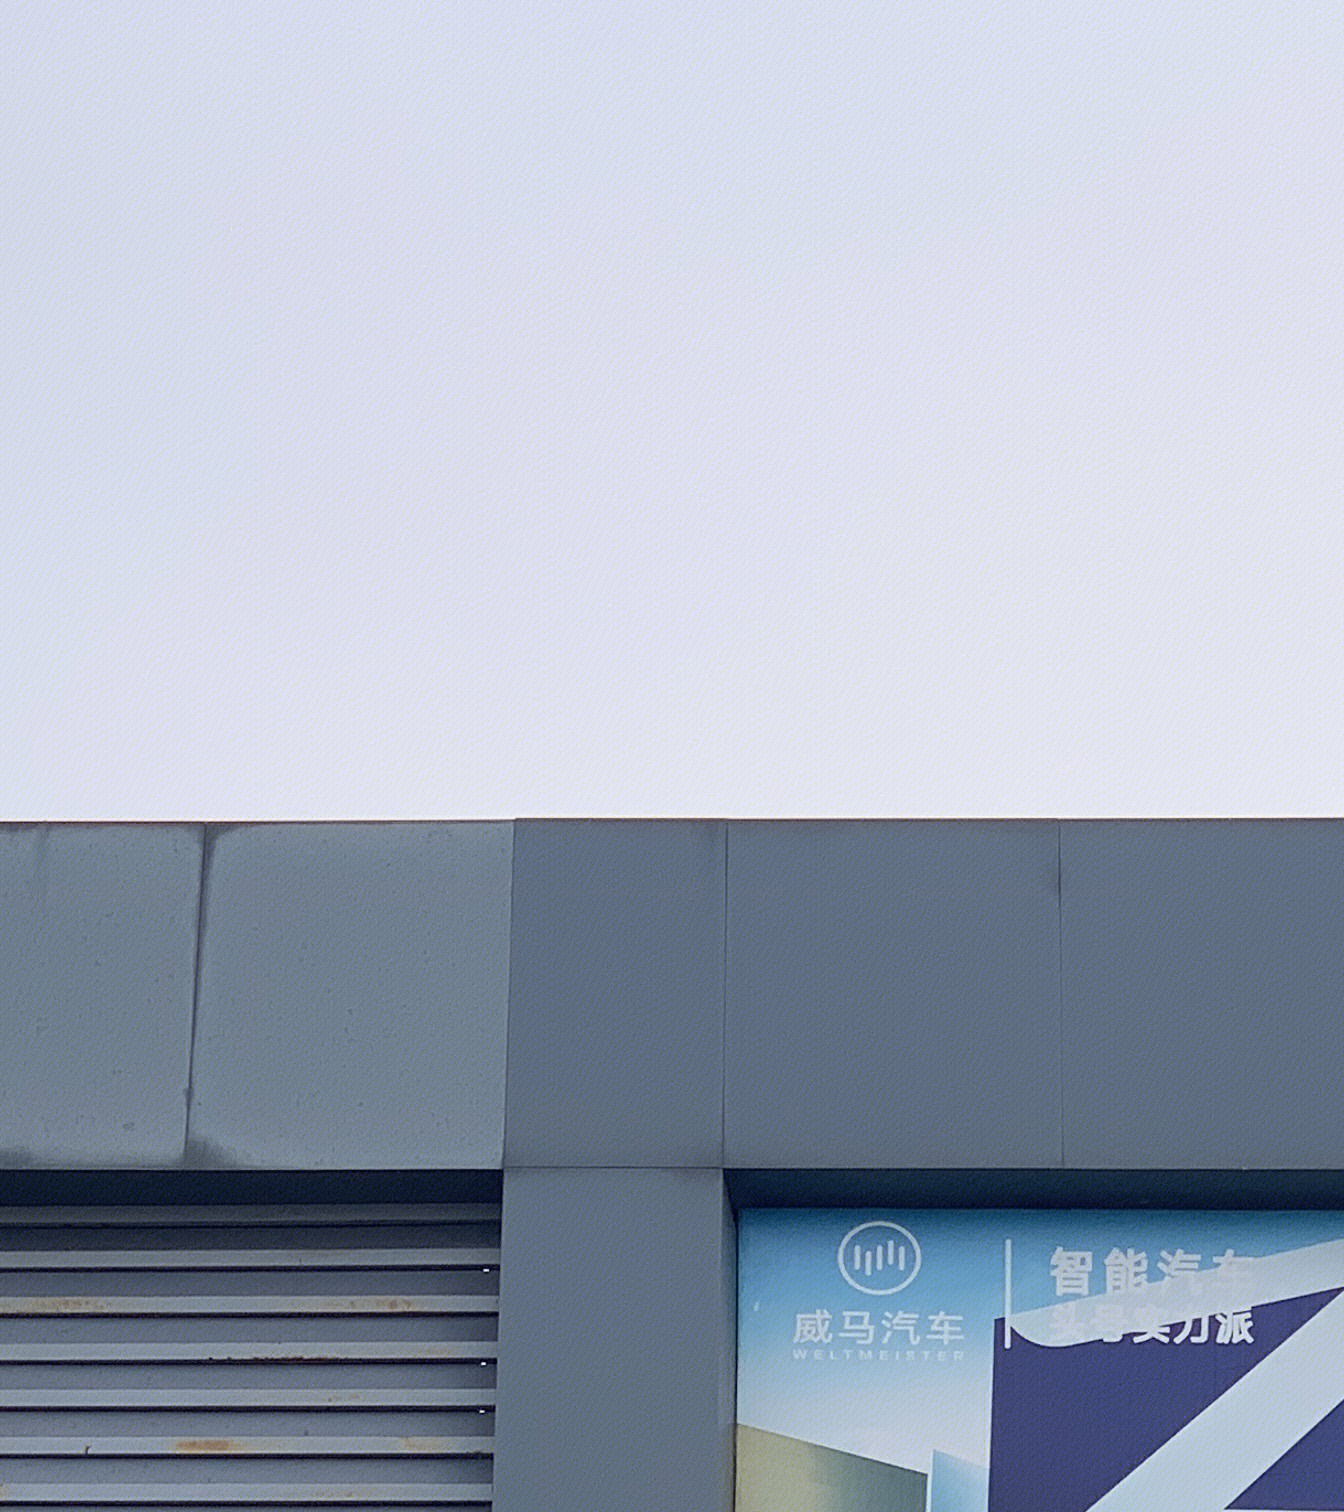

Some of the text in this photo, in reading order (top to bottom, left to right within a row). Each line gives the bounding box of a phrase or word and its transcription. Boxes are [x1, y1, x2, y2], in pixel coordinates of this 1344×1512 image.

[792, 1308, 965, 1345] 威马汽车
[792, 1349, 965, 1361] WELTMEISTER
